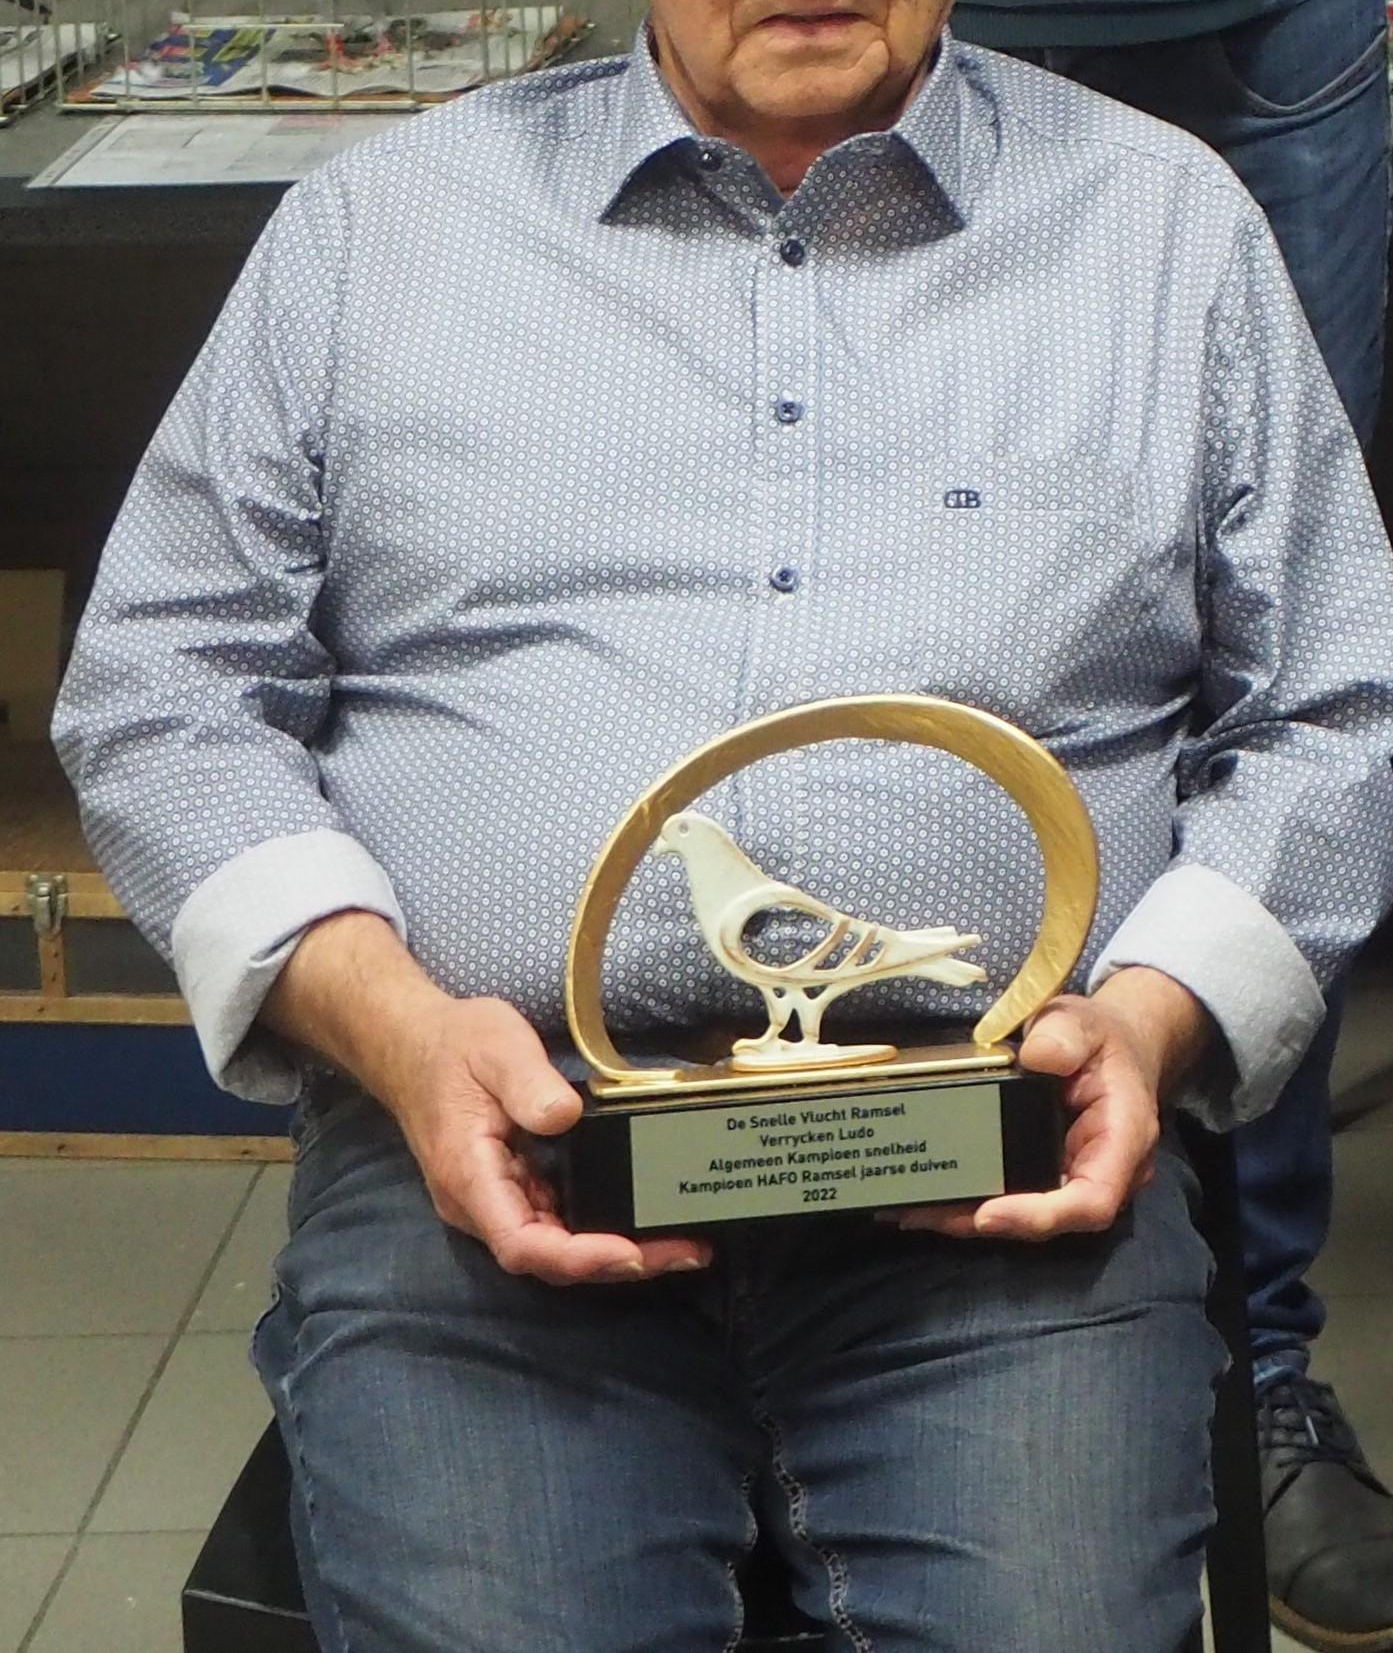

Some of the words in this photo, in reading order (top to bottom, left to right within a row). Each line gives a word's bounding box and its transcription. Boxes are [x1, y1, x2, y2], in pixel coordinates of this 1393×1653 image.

[726, 1118, 746, 1130] De
[750, 1115, 796, 1128] Snelle
[800, 1109, 846, 1124] Vlucht
[851, 1103, 906, 1120] Ramsel
[760, 1130, 834, 1147] Verrycken
[840, 1126, 875, 1140] Ludo
[709, 1157, 783, 1173] Algemeen
[788, 1148, 861, 1164] Kampioen
[865, 1140, 927, 1157] snelheid
[679, 1179, 753, 1195] Kampioen
[757, 1171, 798, 1186] HAFO
[802, 1165, 856, 1183] Ramsel
[860, 1164, 906, 1181] jaarse
[910, 1158, 958, 1173] duiven
[802, 1187, 837, 1202] 2022
